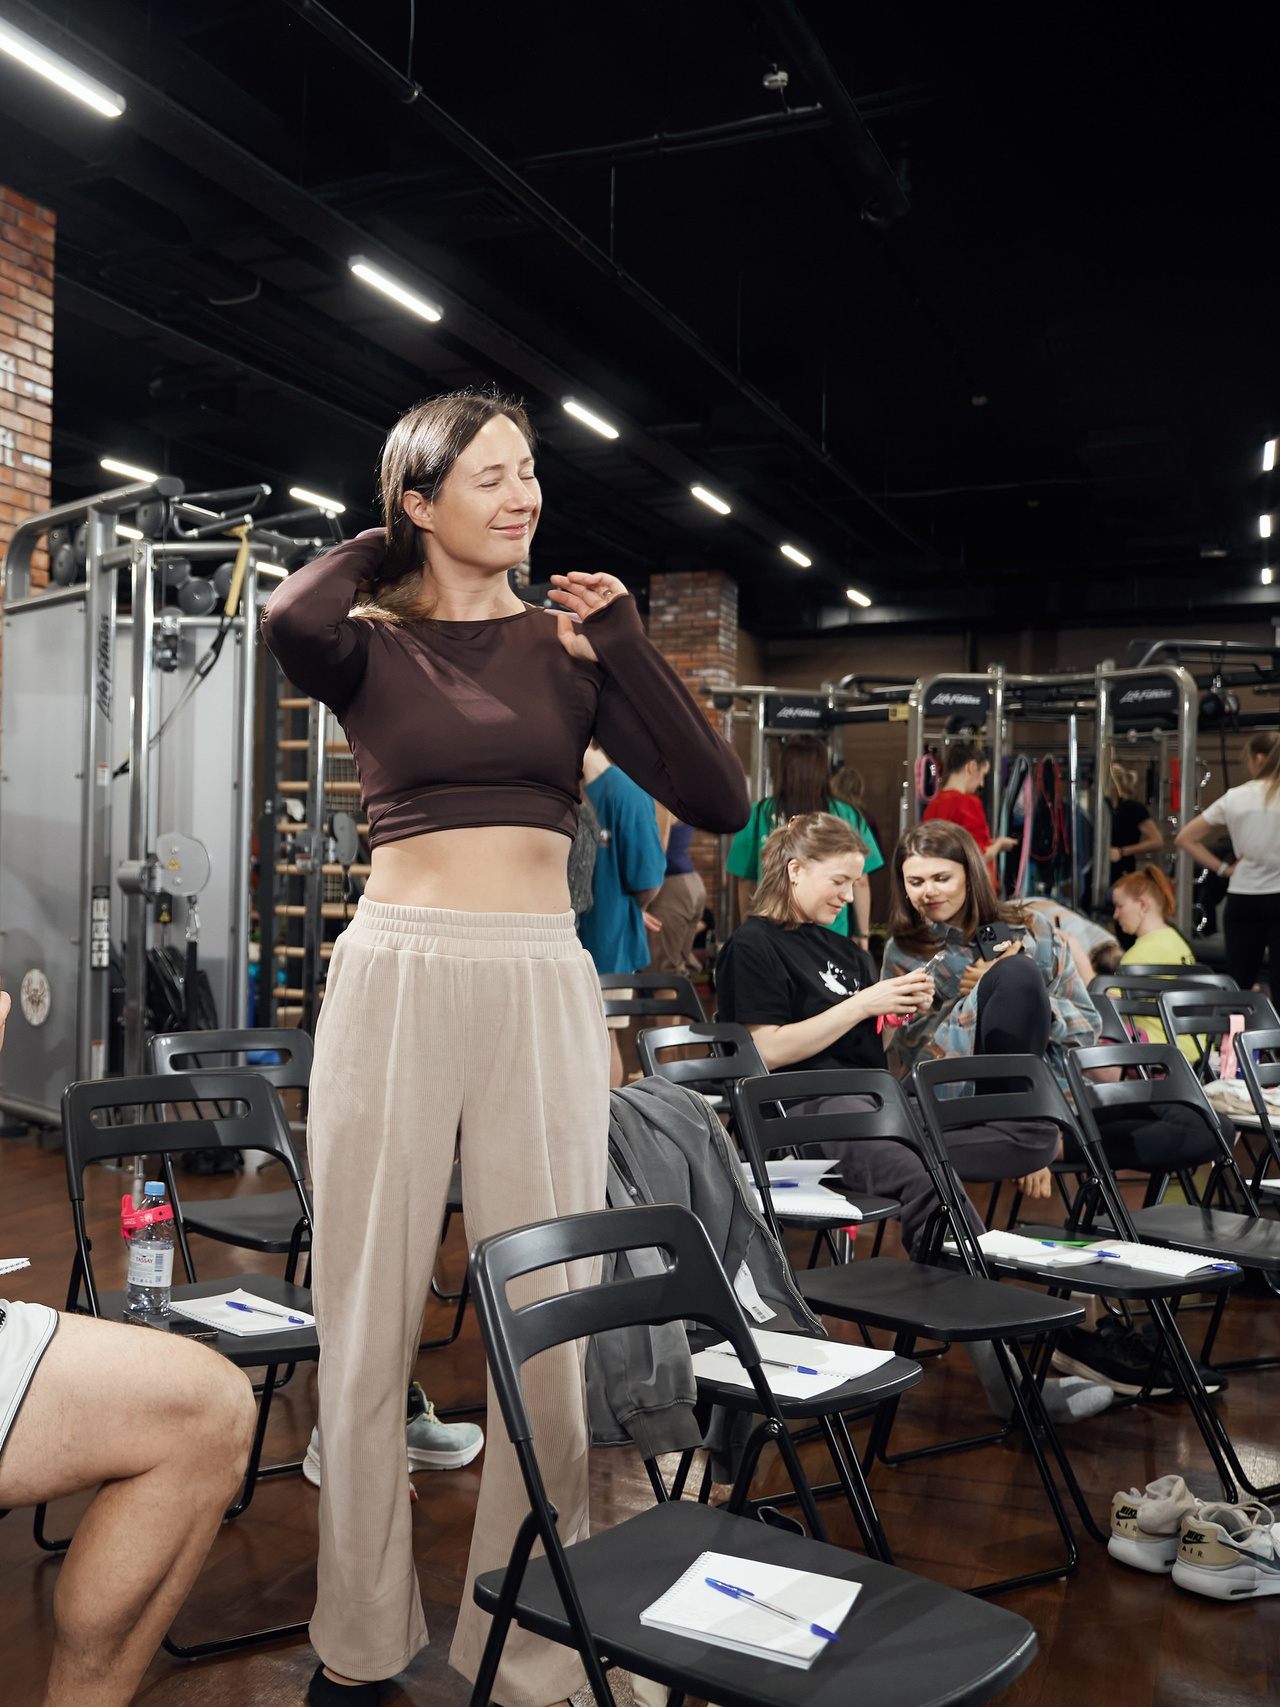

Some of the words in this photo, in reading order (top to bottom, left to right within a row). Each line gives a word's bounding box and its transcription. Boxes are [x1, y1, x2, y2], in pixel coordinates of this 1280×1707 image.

[1120, 1505, 1138, 1517] NIK
[1116, 1521, 1137, 1532] AIR
[1185, 1529, 1206, 1540] NIKE
[1181, 1545, 1203, 1558] AIR
